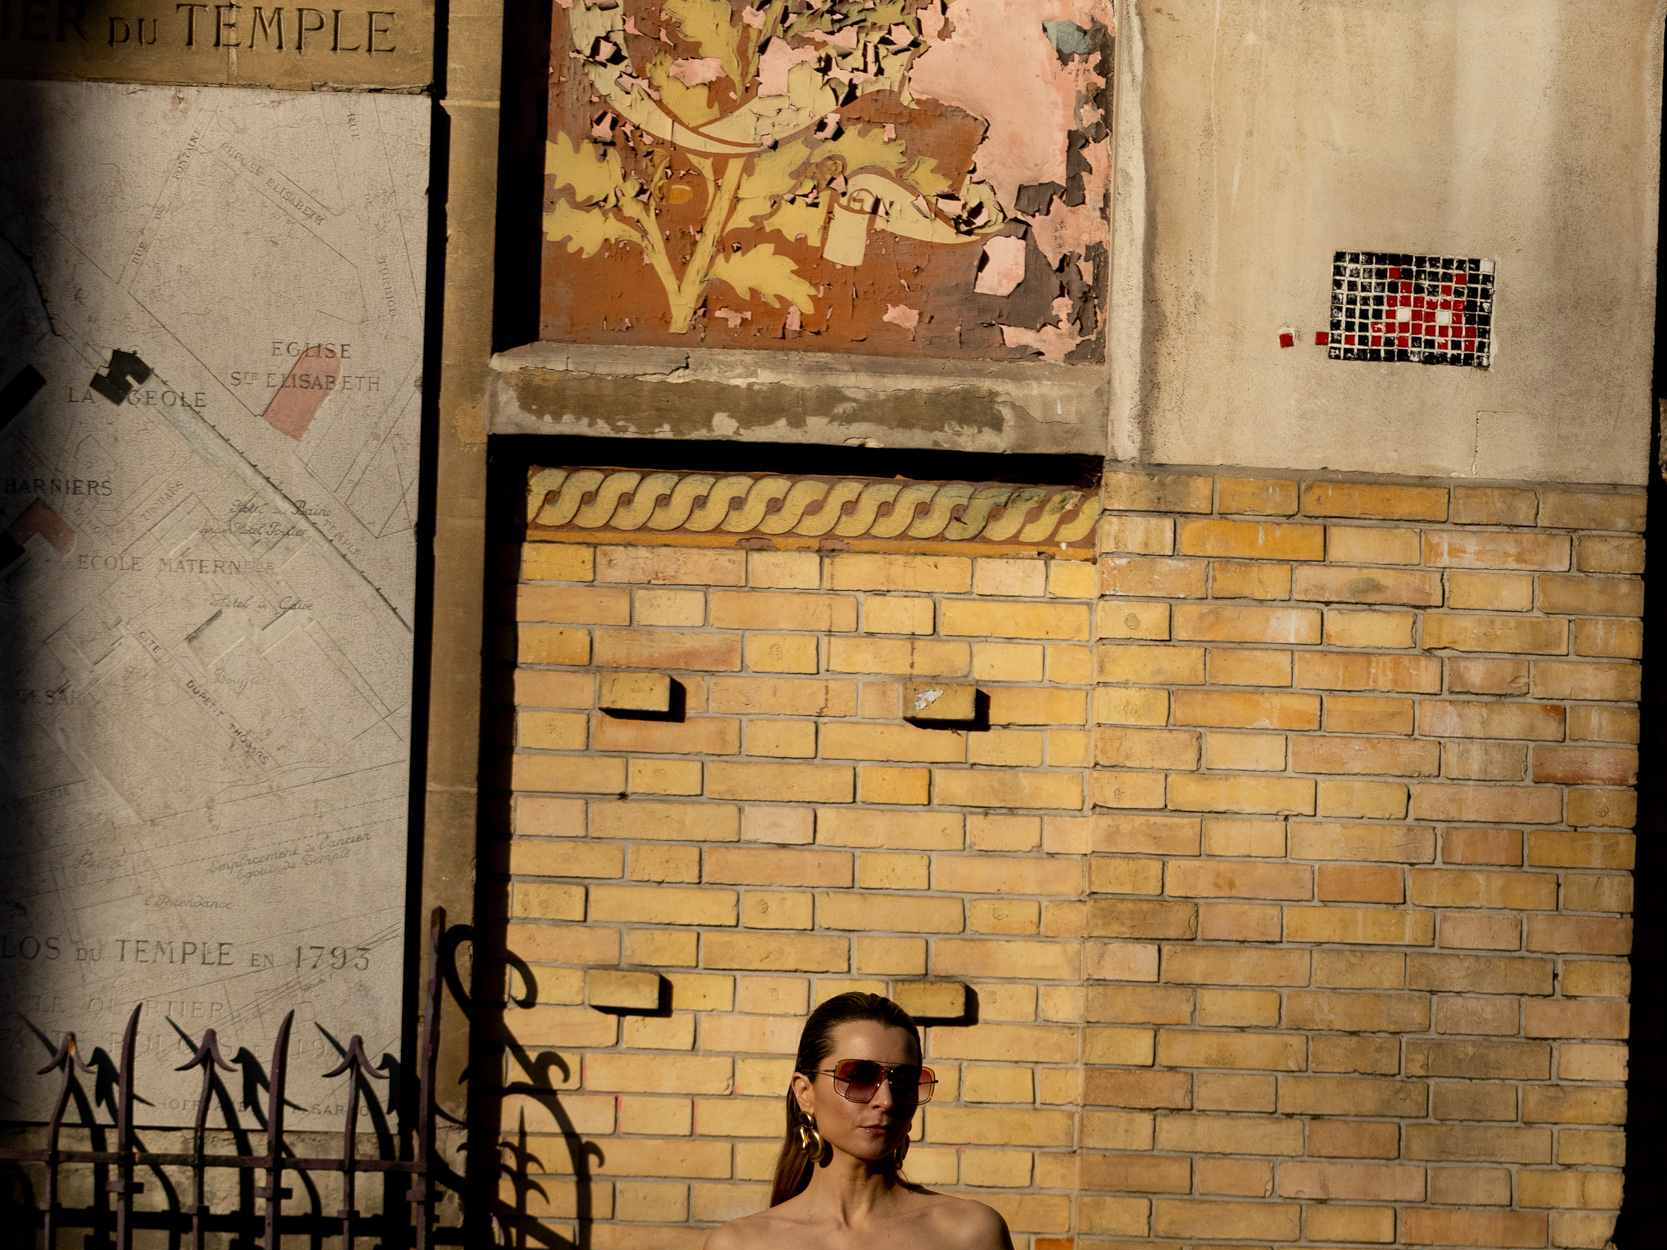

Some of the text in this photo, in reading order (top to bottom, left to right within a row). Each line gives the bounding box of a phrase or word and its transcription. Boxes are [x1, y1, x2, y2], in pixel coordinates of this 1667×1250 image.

[108, 16, 158, 47] DU
[176, 3, 397, 54] TEMPLE
[270, 341, 353, 360] EGLISE
[266, 372, 381, 392] ELISABETH
[67, 387, 207, 408] LA GEOLE
[77, 554, 144, 573] ECOLE
[138, 631, 162, 654] CITE
[75, 947, 103, 963] DU
[115, 939, 235, 967] TEMPLE
[250, 953, 276, 969] EN
[295, 945, 372, 972] 1793
